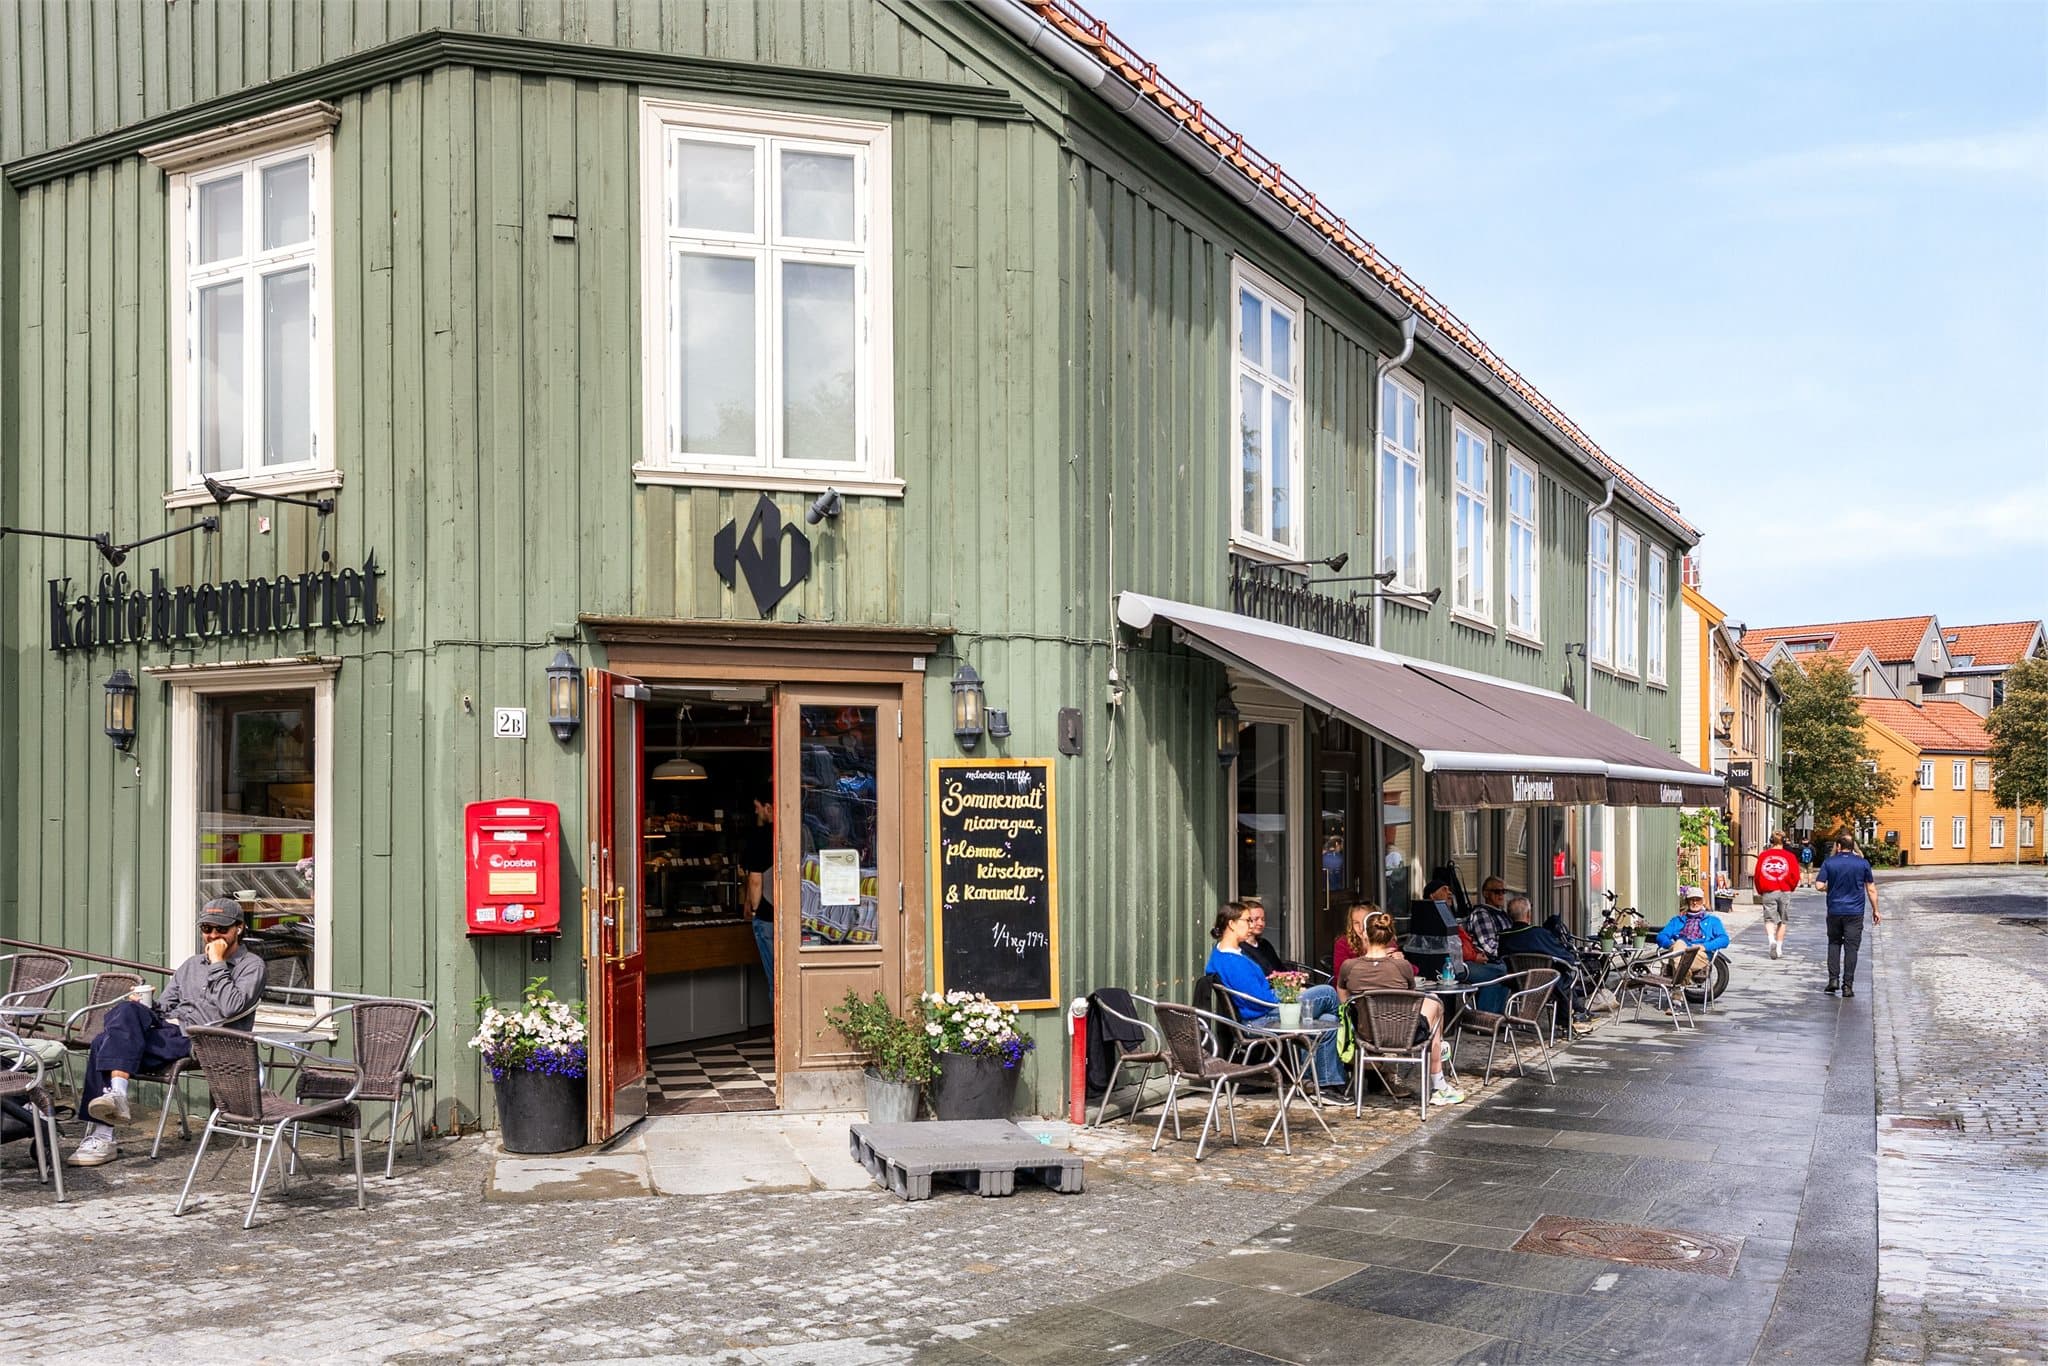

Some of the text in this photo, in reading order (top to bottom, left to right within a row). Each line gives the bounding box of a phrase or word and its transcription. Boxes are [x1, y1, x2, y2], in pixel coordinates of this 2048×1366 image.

[500, 713, 520, 733] 2B
[942, 782, 1044, 816] Sommernatt
[503, 858, 537, 869] posten
[946, 884, 960, 903] &
